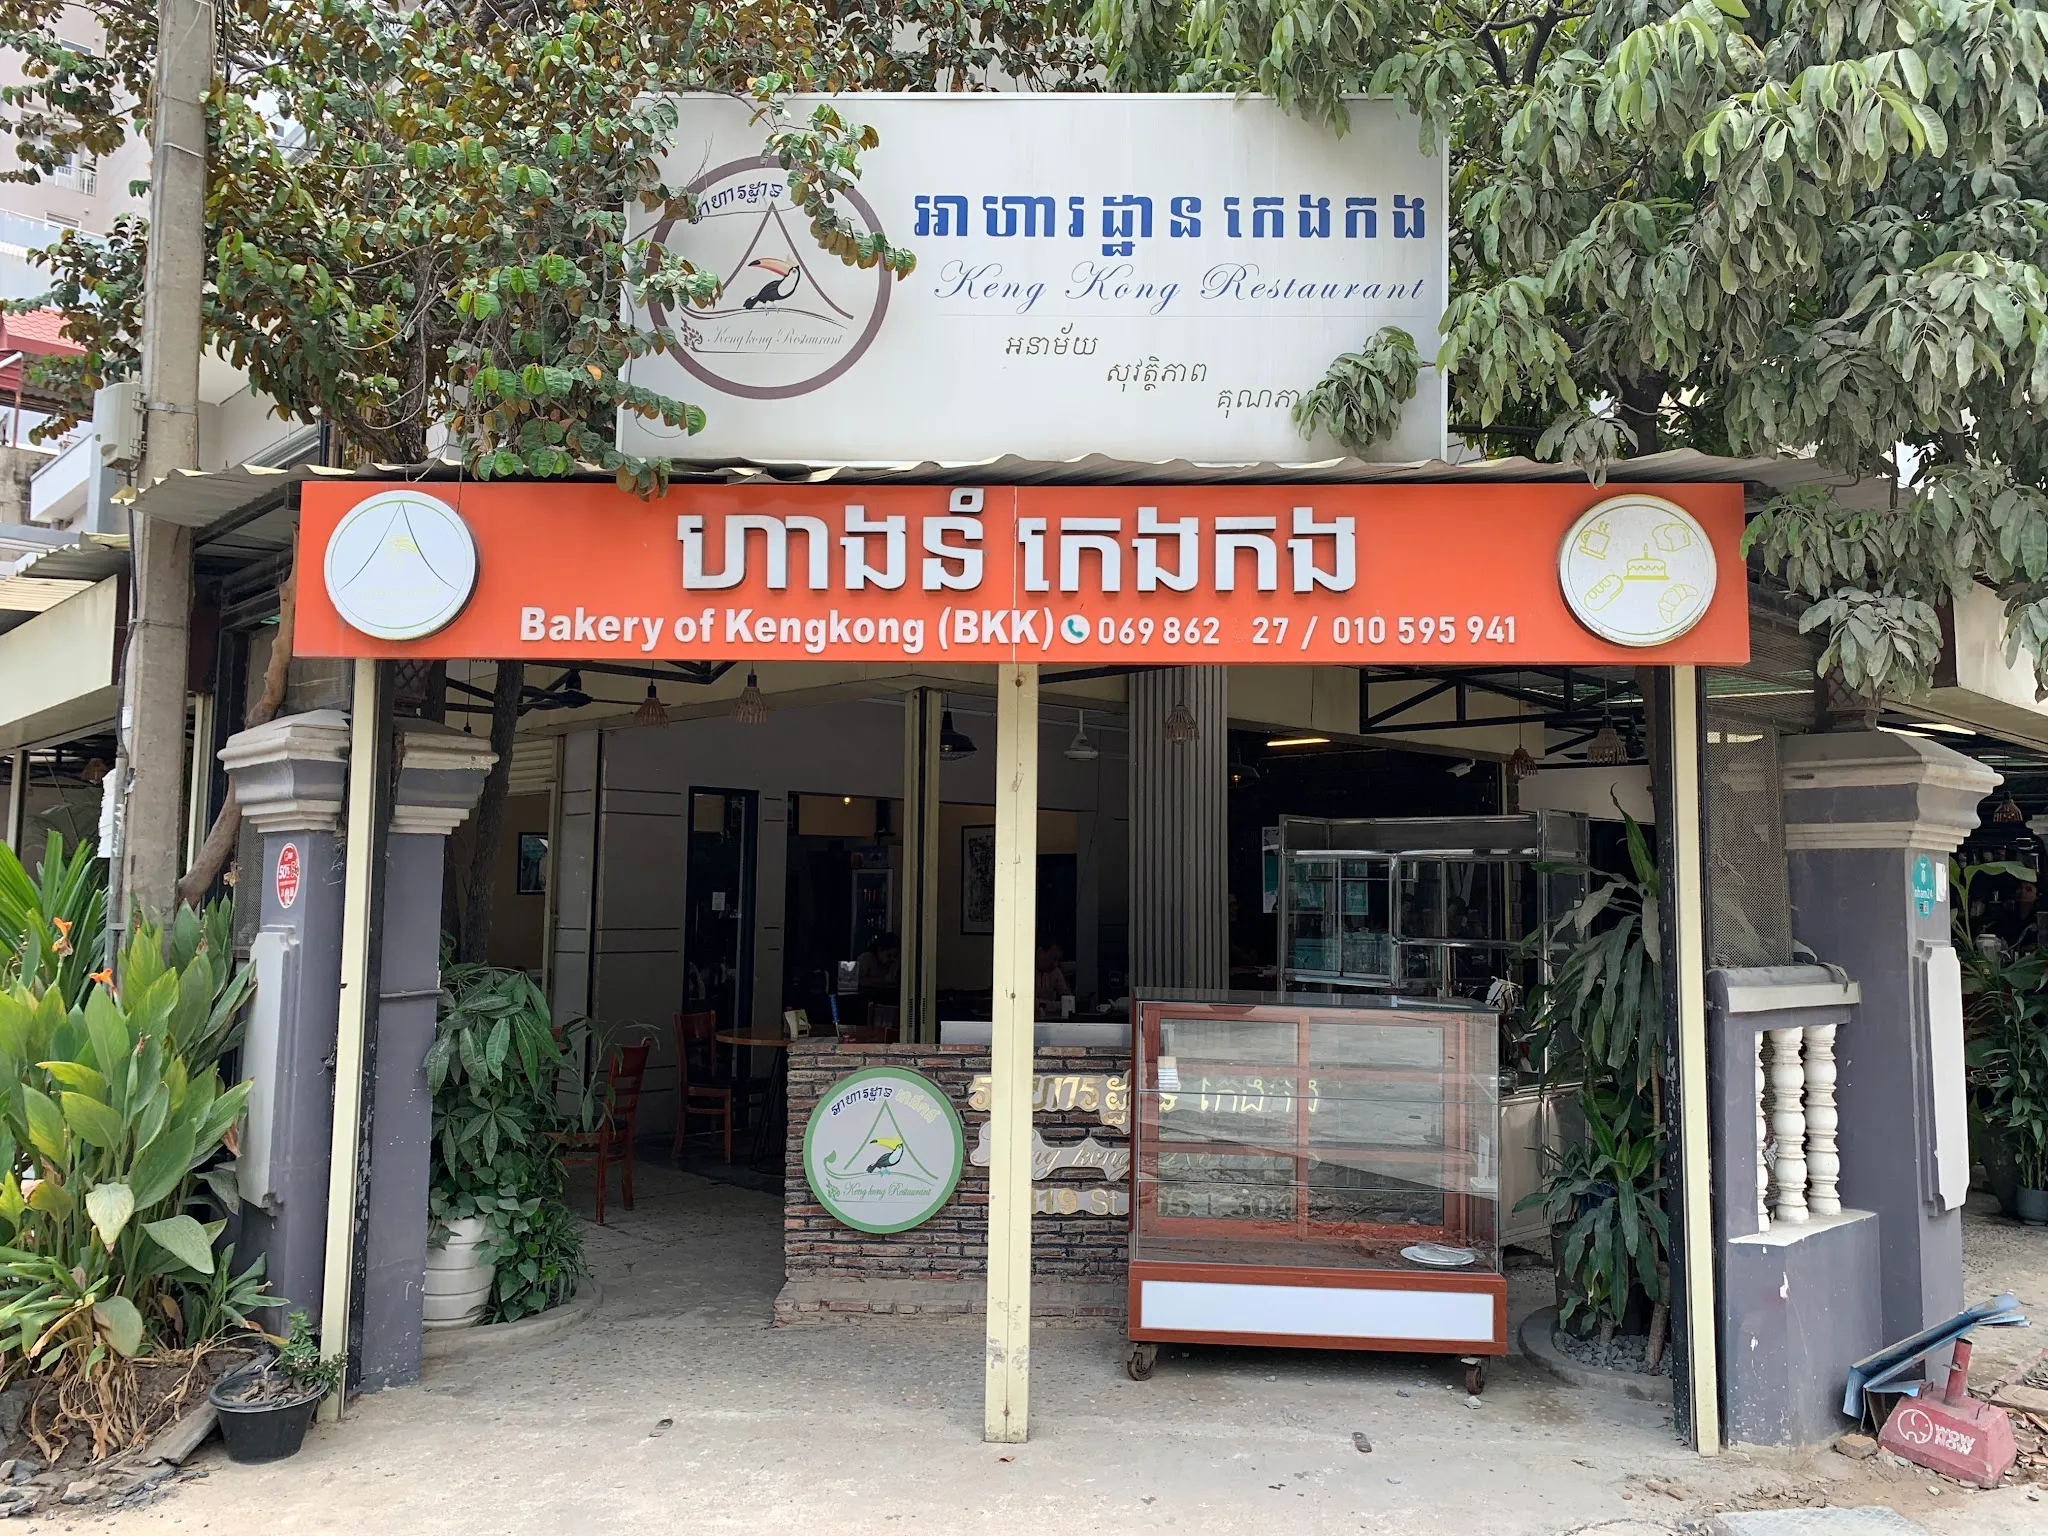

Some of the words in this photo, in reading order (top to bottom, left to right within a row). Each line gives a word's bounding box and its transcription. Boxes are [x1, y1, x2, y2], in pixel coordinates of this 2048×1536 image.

[914, 194, 1202, 257] អាហារដ្ឋាន
[1223, 194, 1426, 239] កេងកង
[934, 259, 1047, 315] Keng
[1064, 260, 1181, 316] Kong
[1200, 262, 1425, 301] Restaurant
[776, 326, 845, 346] Restaurant
[1005, 322, 1099, 356] អនាម័យ
[1216, 388, 1304, 419] គុណភា
[676, 487, 985, 592] ហាងនំ
[1018, 506, 1358, 594] កេងកង
[519, 606, 664, 652] Bakery
[674, 605, 714, 643] of
[726, 608, 924, 653] Kengkong
[938, 606, 1054, 651] (BKK)
[1098, 616, 1155, 645] 069
[1163, 616, 1220, 645] 862
[1252, 616, 1289, 645] 27
[1332, 616, 1385, 645] 010
[1398, 616, 1456, 646] 595
[1467, 616, 1516, 646] 941
[1934, 1424, 1977, 1447] WOW
